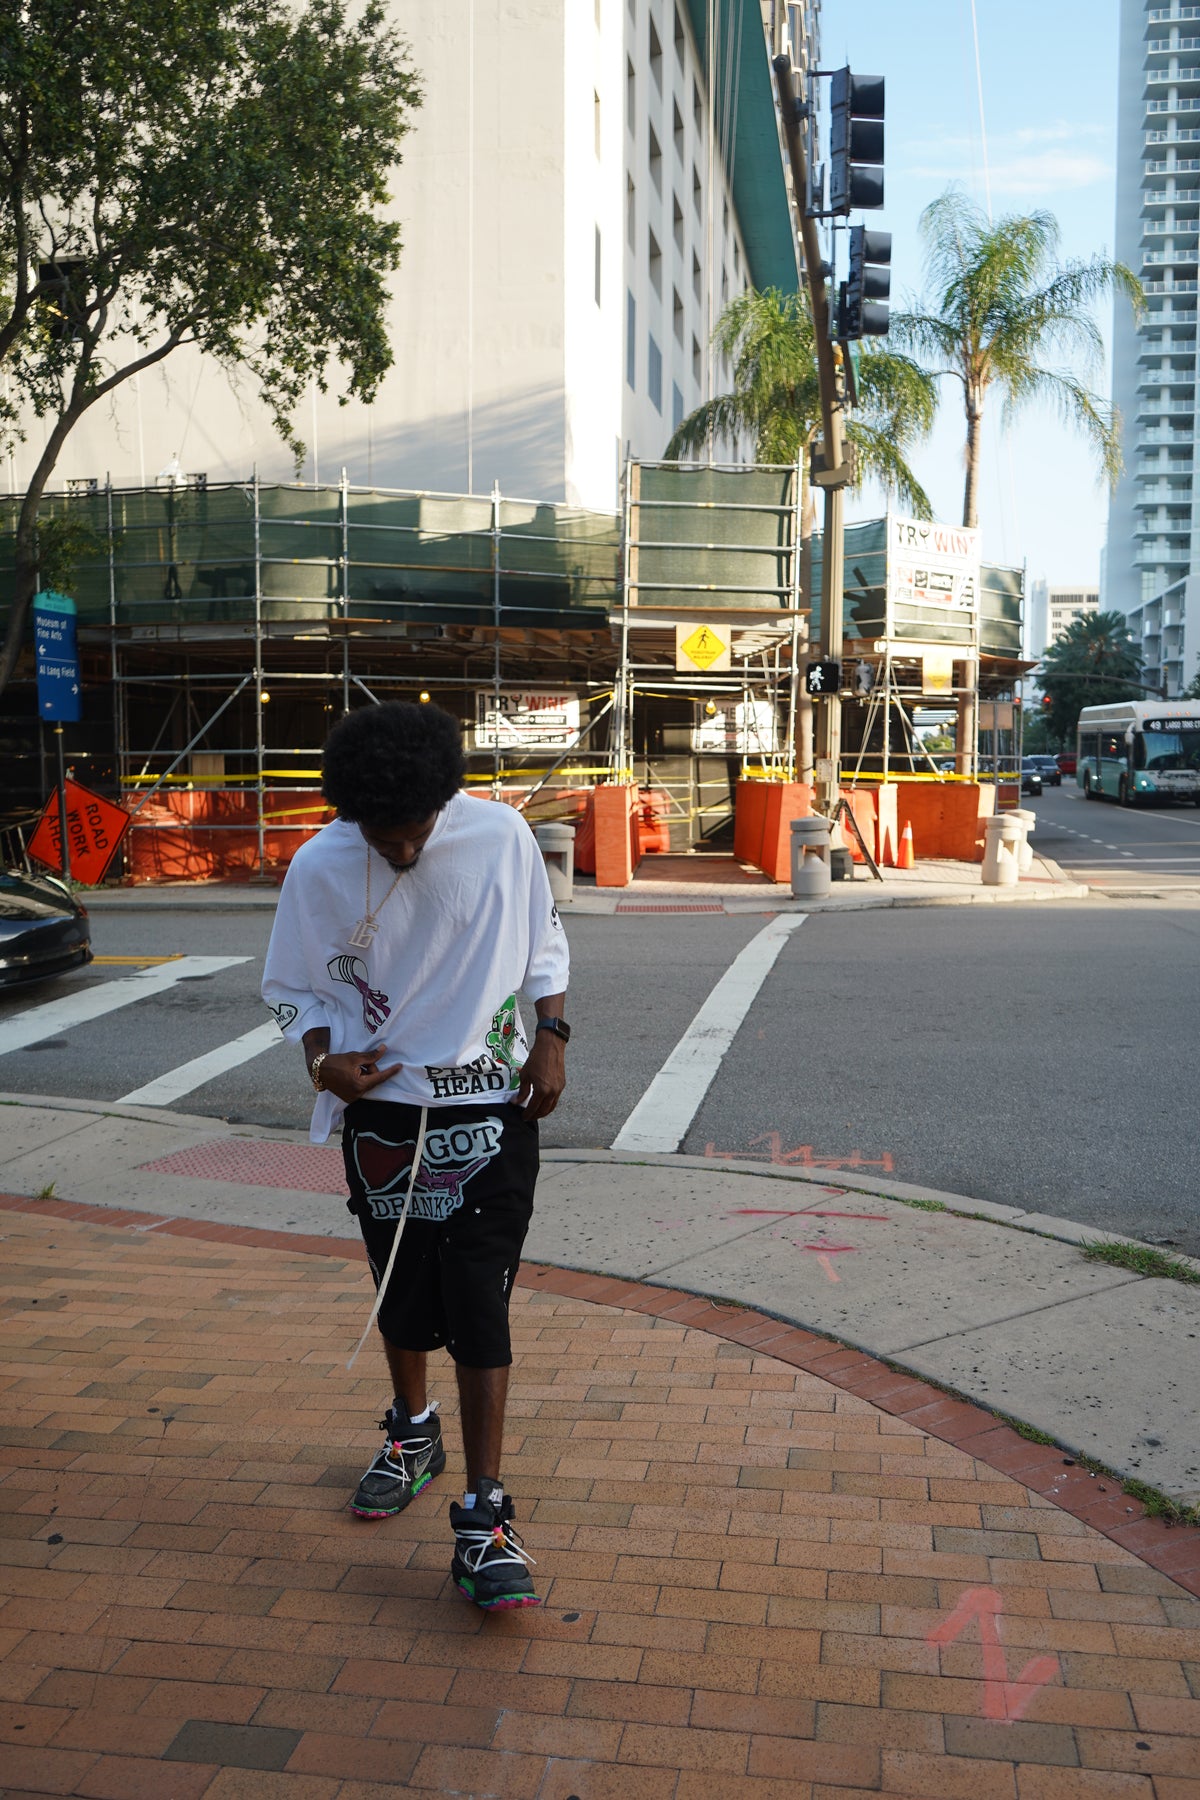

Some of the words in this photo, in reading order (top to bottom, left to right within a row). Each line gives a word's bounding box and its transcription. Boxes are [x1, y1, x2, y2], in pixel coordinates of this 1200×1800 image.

[896, 522, 931, 549] TRY
[36, 616, 60, 628] Museum
[60, 620, 67, 629] of
[37, 628, 50, 639] Fine
[51, 630, 63, 641] Arts
[47, 666, 60, 679] Lang
[61, 667, 76, 678] Field
[487, 693, 522, 711] TRY
[525, 695, 569, 711] WINE
[1150, 720, 1161, 730] 49
[1164, 720, 1181, 729] LARGO
[66, 809, 90, 858] WORK
[85, 803, 109, 850] ROAD
[424, 1053, 502, 1080] PINT
[430, 1072, 505, 1099] HEAD
[425, 1125, 497, 1160] GOT
[371, 1195, 455, 1218] DRANK?
